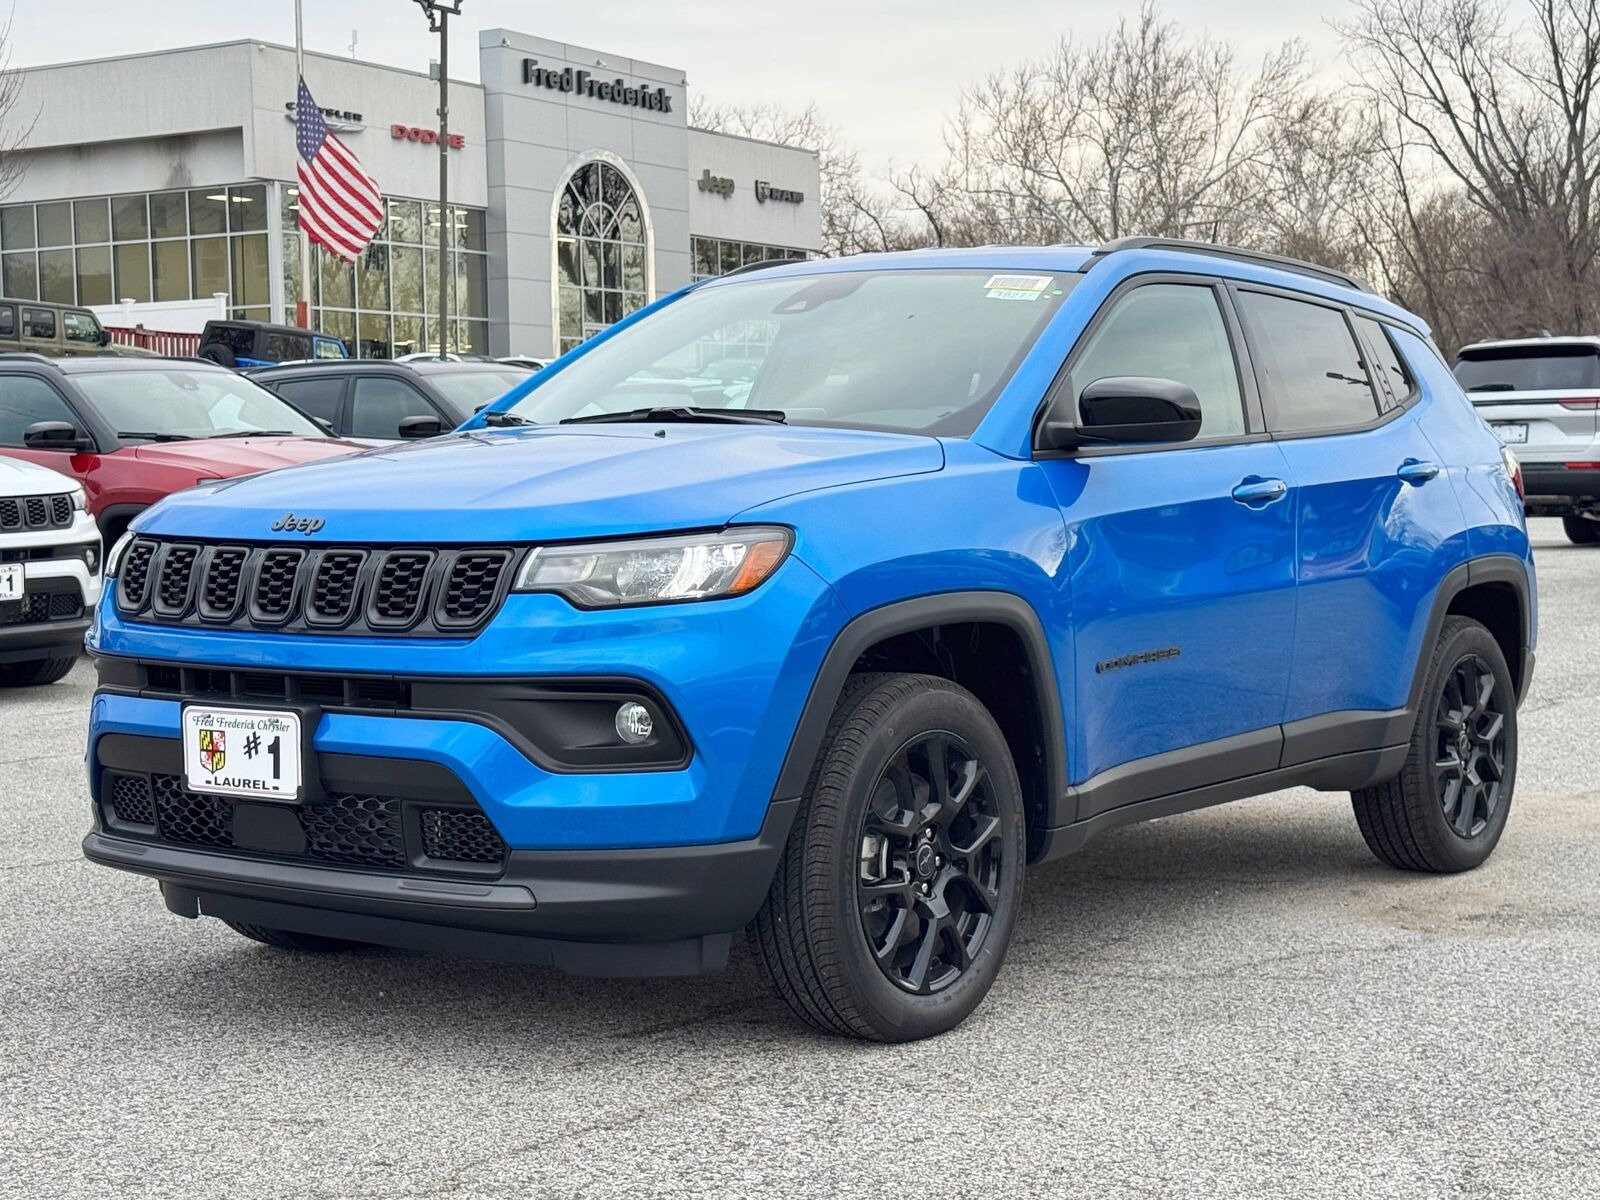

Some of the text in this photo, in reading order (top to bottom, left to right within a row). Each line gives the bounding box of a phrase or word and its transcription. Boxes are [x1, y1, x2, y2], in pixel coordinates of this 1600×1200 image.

[523, 58, 673, 113] Fred Frederick
[697, 169, 735, 200] Jeep
[271, 512, 326, 536] Jeep
[192, 715, 290, 733] Fred Frederick Chrysler
[214, 776, 270, 791] LAUREL
